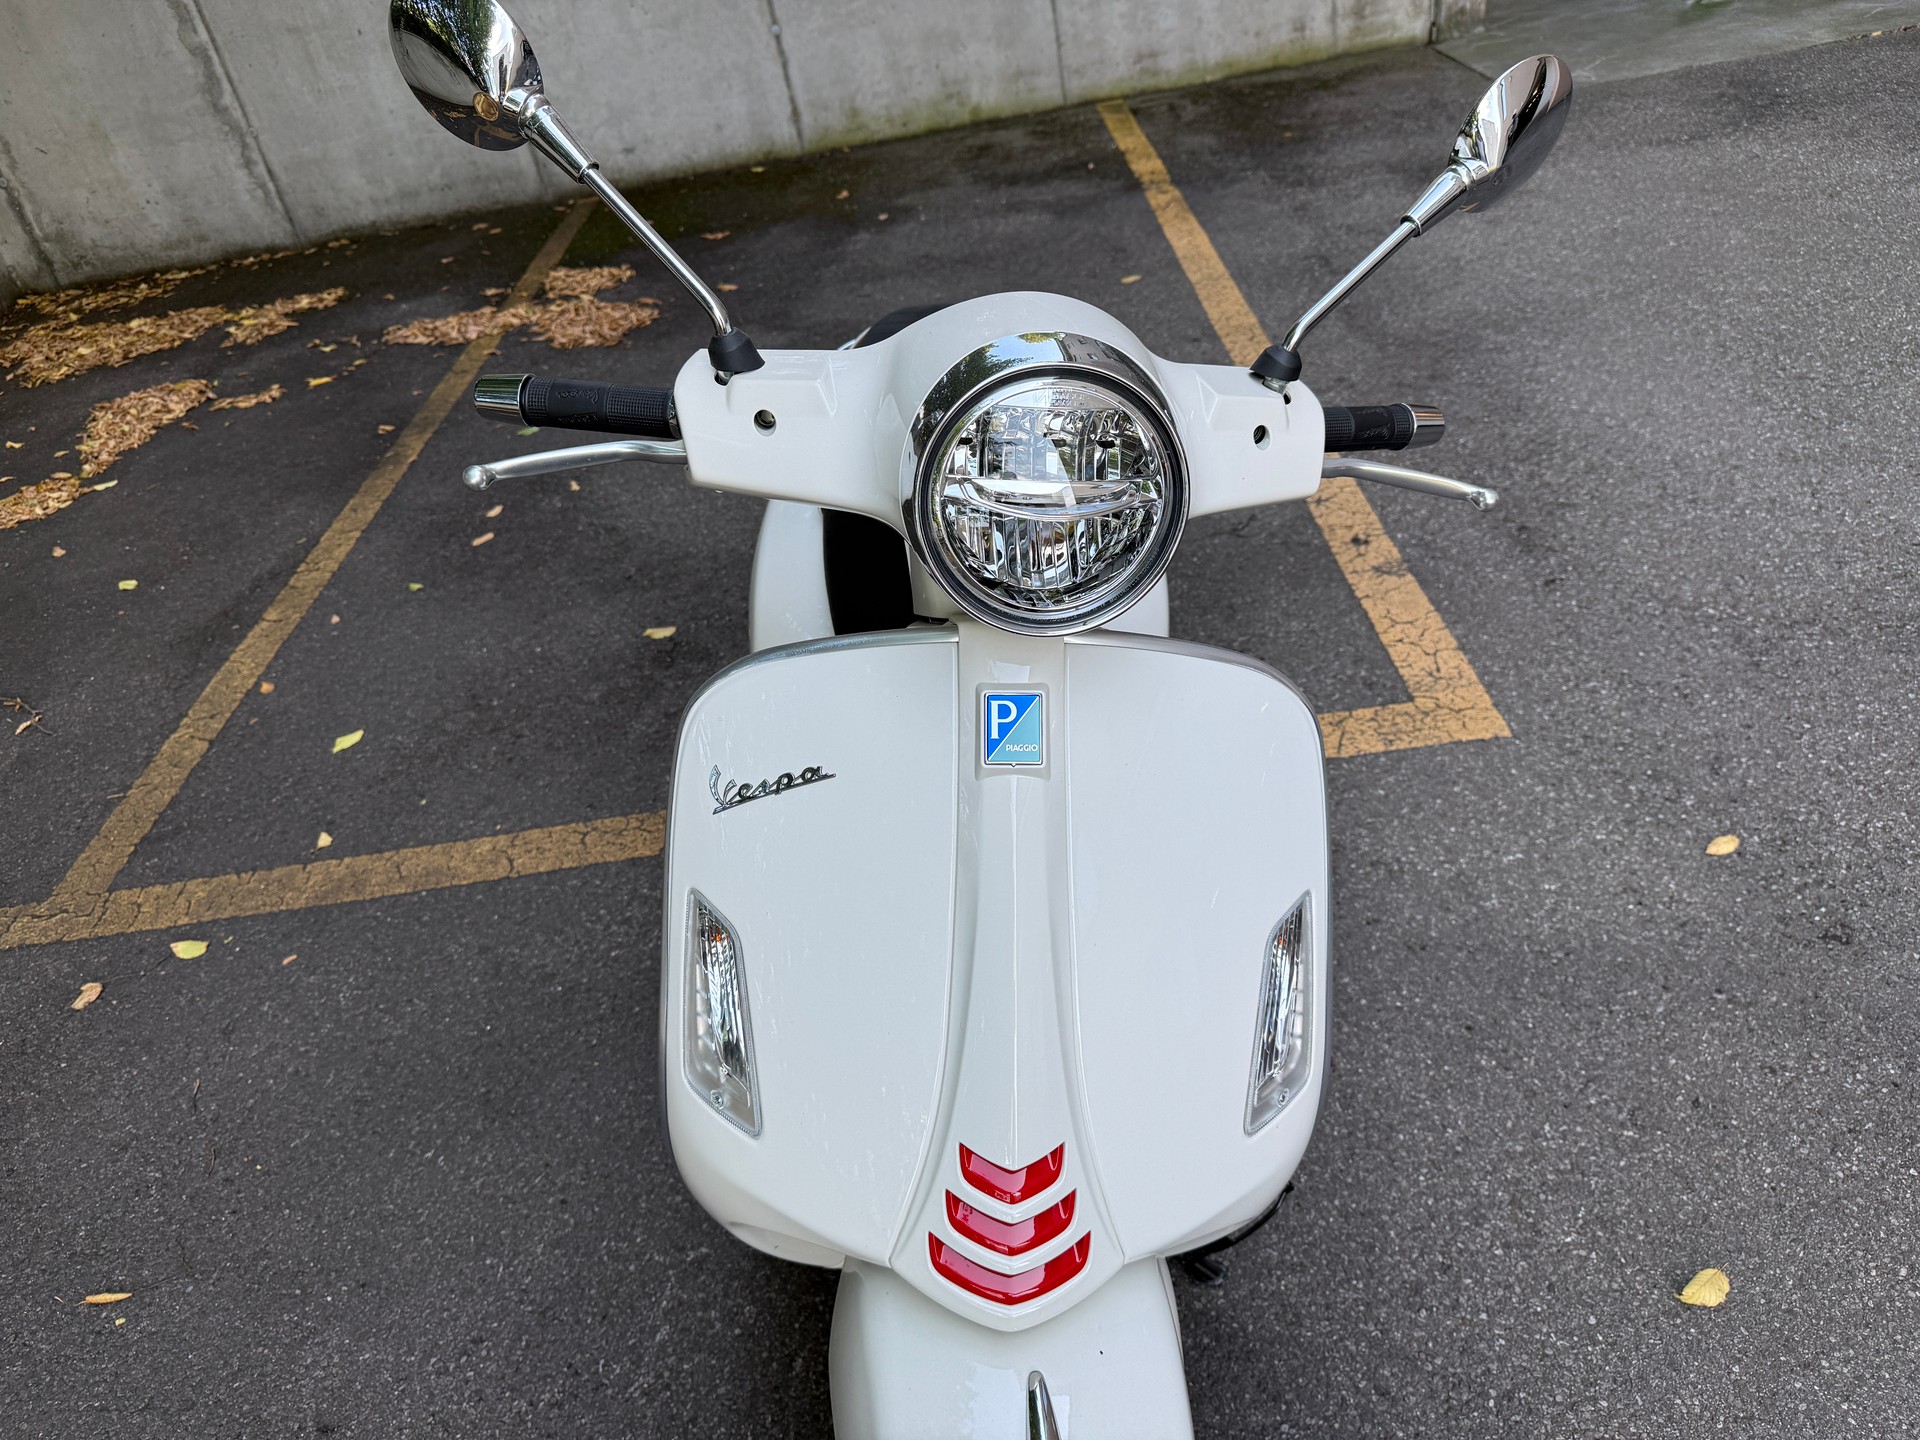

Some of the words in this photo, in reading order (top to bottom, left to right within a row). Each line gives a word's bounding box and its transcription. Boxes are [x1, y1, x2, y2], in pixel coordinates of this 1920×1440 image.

[989, 699, 1018, 739] P
[1005, 743, 1039, 752] PIAGGIO
[709, 764, 836, 815] Vespa
